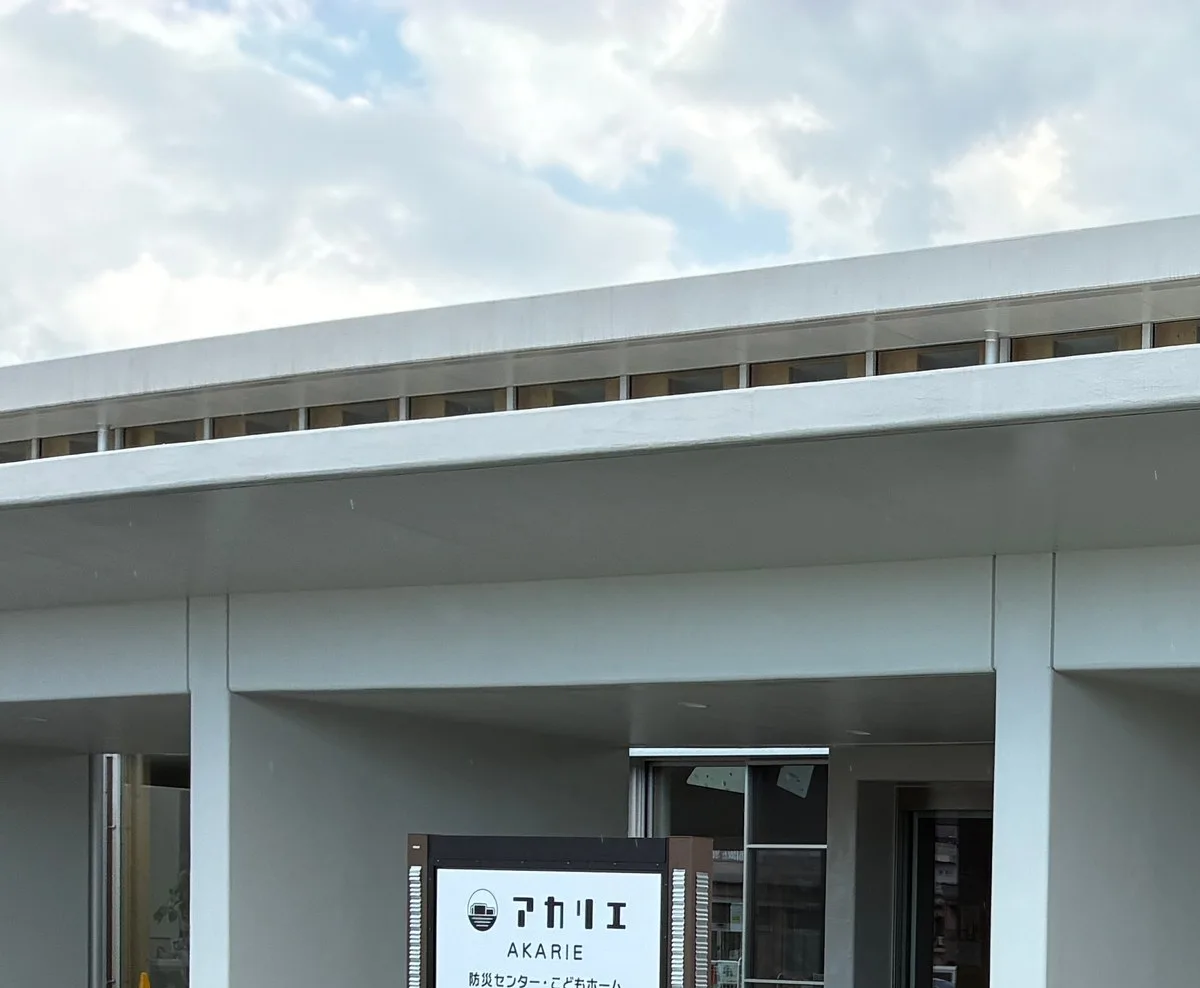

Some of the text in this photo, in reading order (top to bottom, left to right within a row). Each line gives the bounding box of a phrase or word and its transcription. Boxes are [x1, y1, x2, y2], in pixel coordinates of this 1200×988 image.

[513, 896, 626, 929] アカリエ
[507, 942, 583, 960] AKARIE
